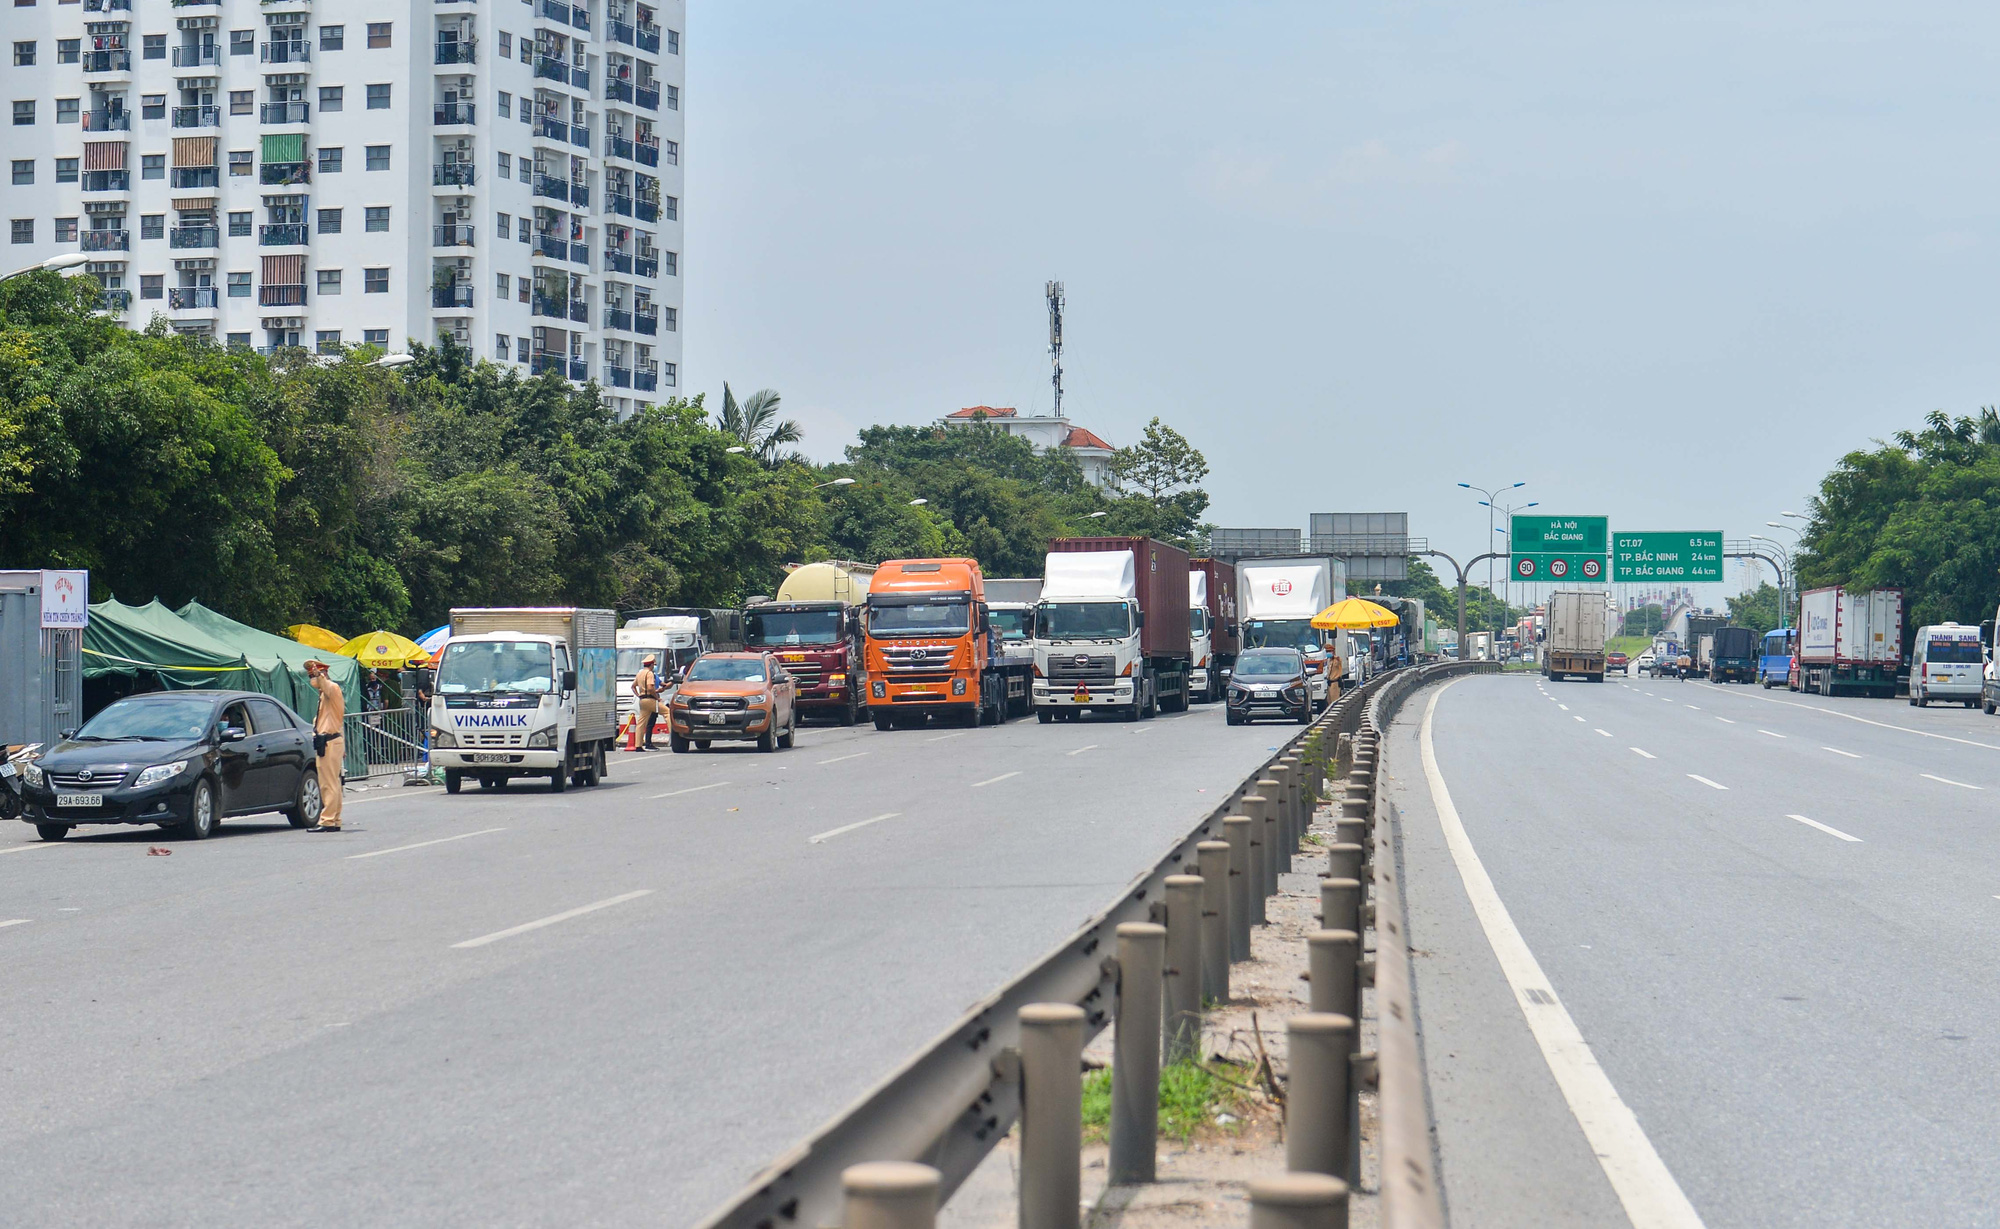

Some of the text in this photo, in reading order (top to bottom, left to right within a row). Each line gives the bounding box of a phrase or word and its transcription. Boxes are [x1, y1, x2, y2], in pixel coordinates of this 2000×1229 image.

[1550, 521, 1578, 530] HÀ NỘI
[1543, 531, 1584, 541] BẮC GIANG
[1619, 538, 1716, 548] CT.07 6.5 km
[1656, 553, 1679, 561] NINH
[1691, 553, 1716, 561] 24 km
[1521, 563, 1532, 572] 90
[1553, 563, 1565, 572] 70
[1585, 564, 1597, 573] 50
[1635, 563, 1654, 575] BẮC
[1656, 567, 1684, 575] GIANG
[1691, 567, 1716, 575] 44 km
[1958, 634, 1977, 642] SANG
[454, 714, 528, 727] VINAMILK
[58, 796, 101, 806] 29A-693.66
